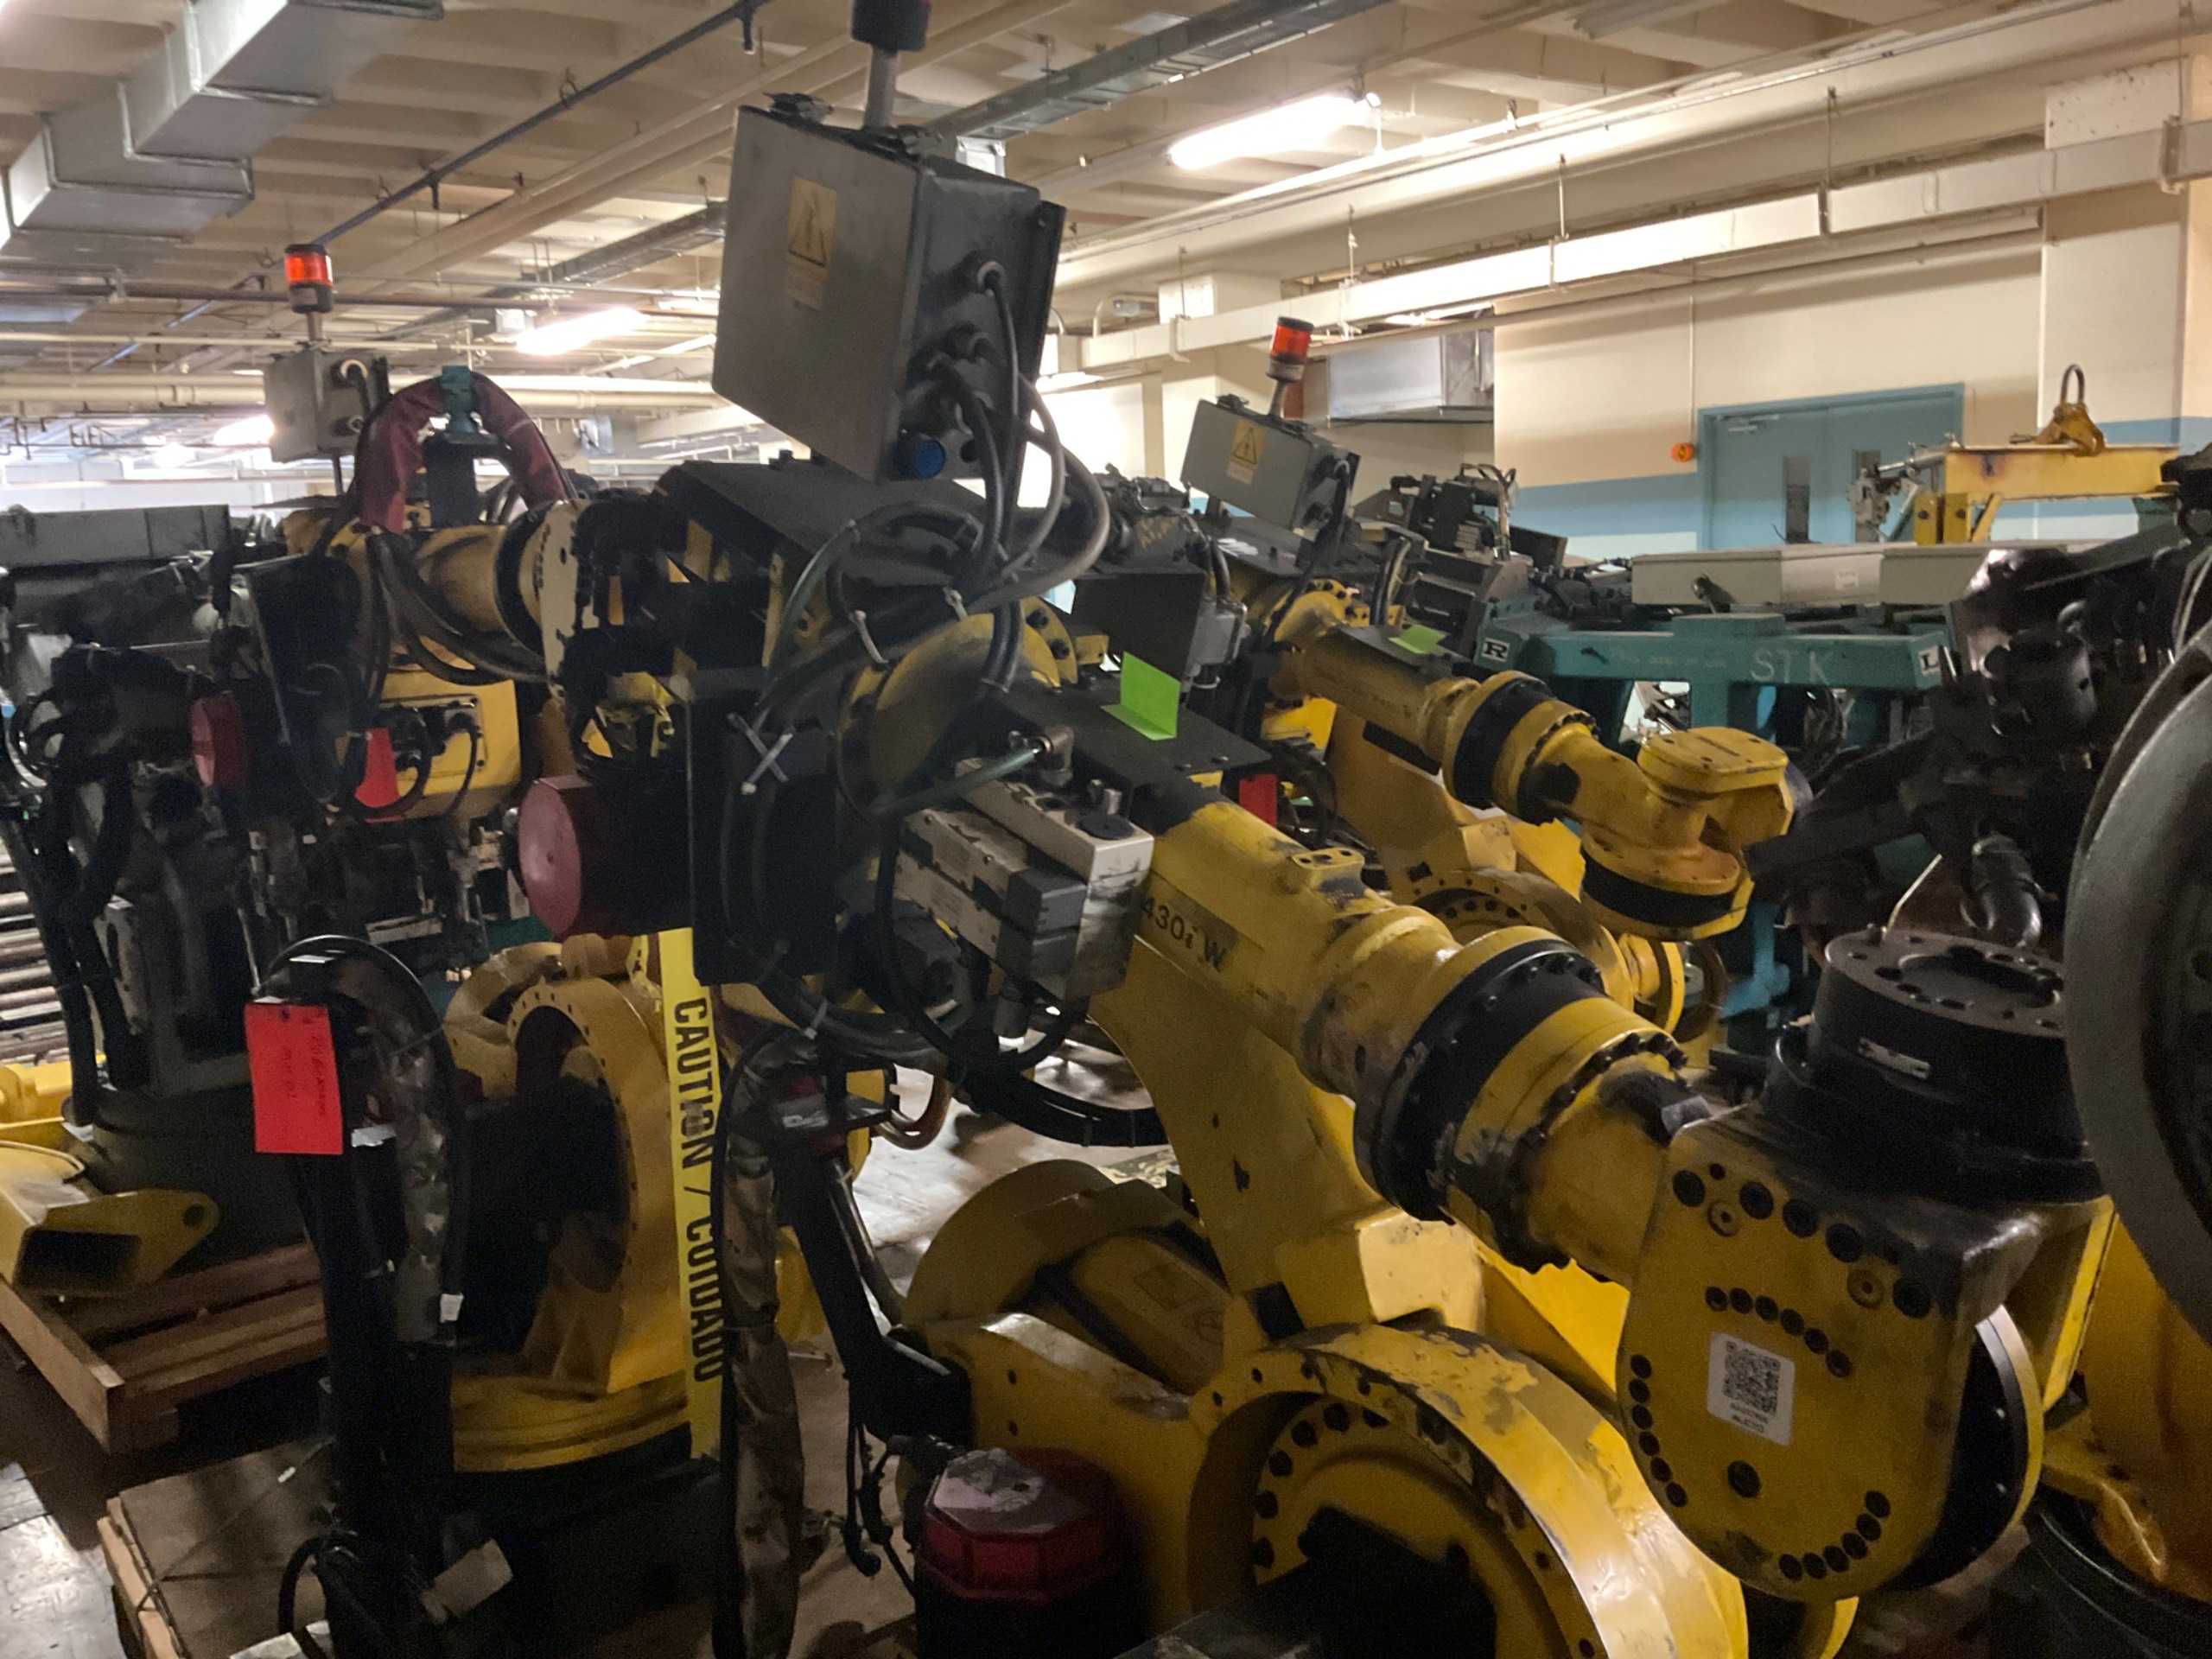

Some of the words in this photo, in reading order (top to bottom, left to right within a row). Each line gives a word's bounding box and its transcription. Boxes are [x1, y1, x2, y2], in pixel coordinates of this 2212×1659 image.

[1484, 639, 1509, 660] R
[1920, 652, 1939, 669] L
[674, 997, 715, 1170] CAUTION
[686, 1216, 724, 1382] CUIDADO
